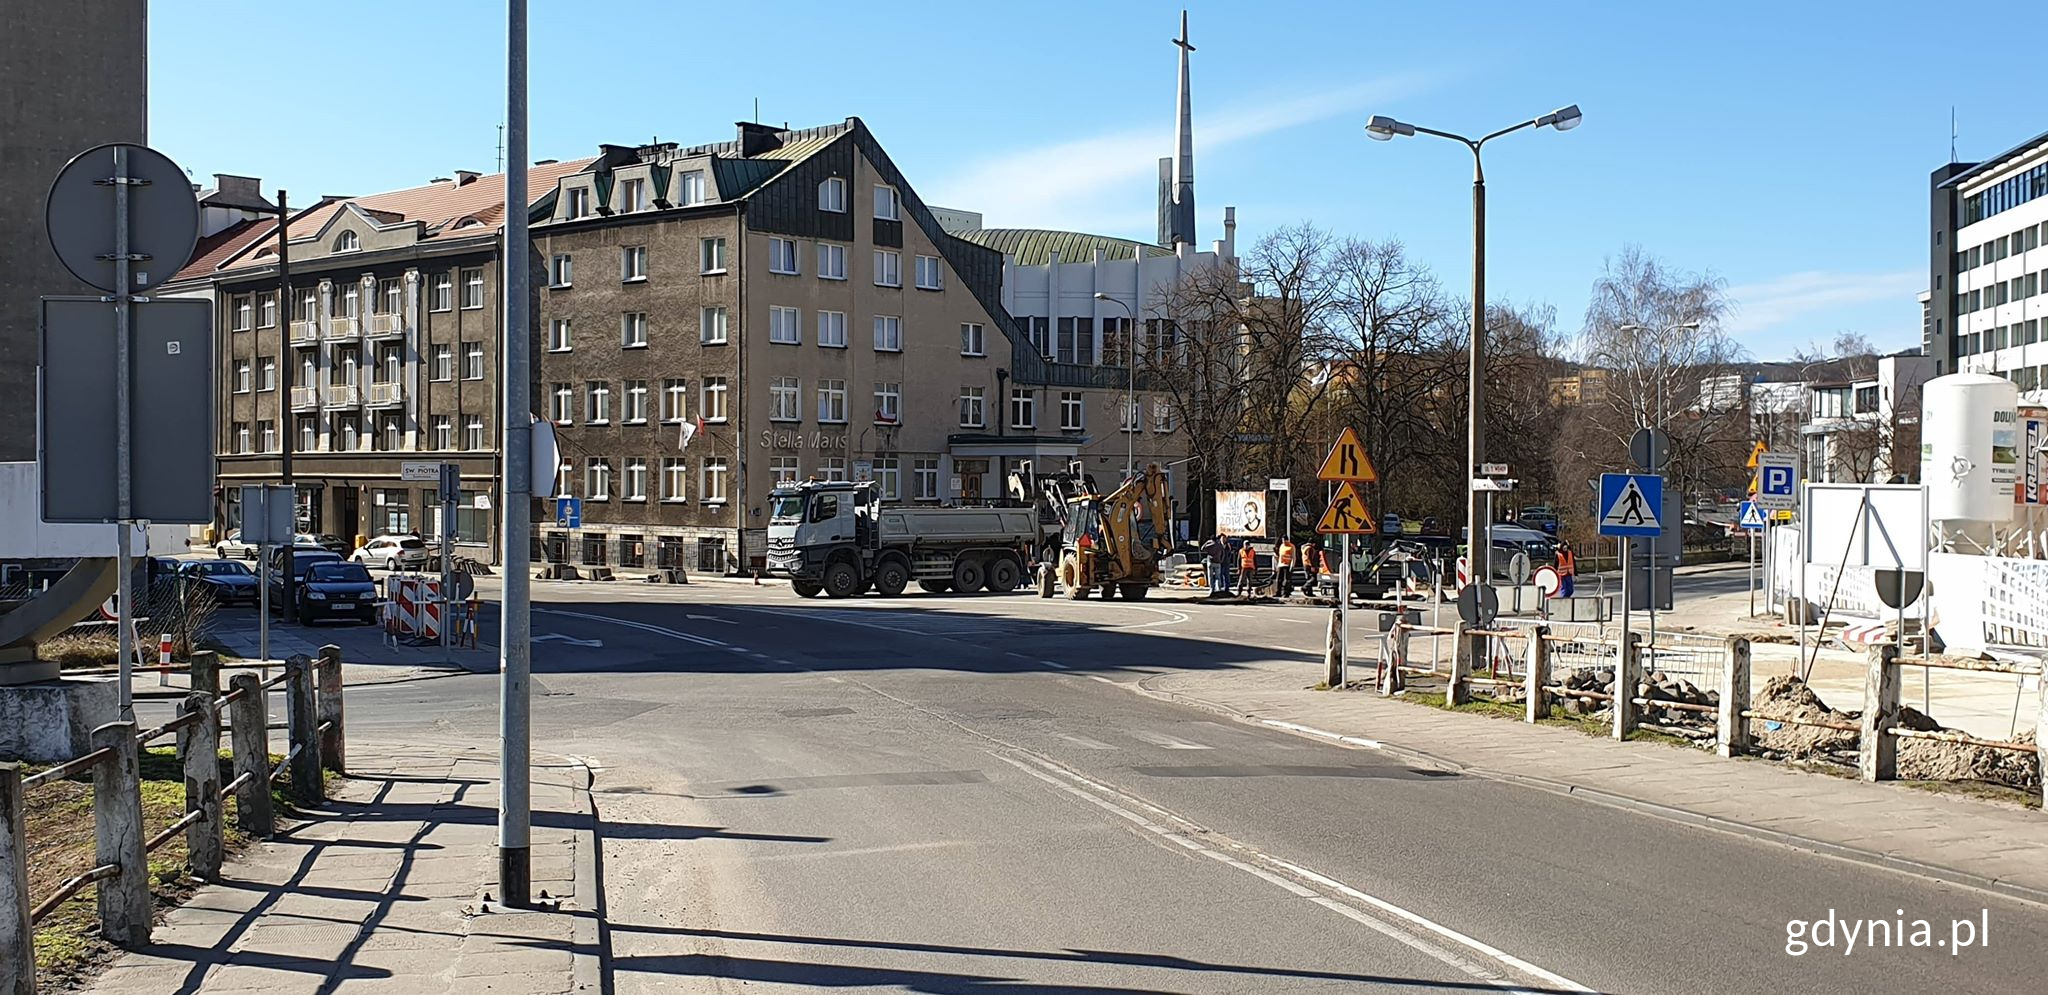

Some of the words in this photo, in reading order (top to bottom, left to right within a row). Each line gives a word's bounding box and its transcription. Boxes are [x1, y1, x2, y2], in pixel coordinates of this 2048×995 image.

[760, 430, 803, 448] Stella
[807, 431, 847, 449] Maris
[2027, 424, 2038, 501] KREISEL
